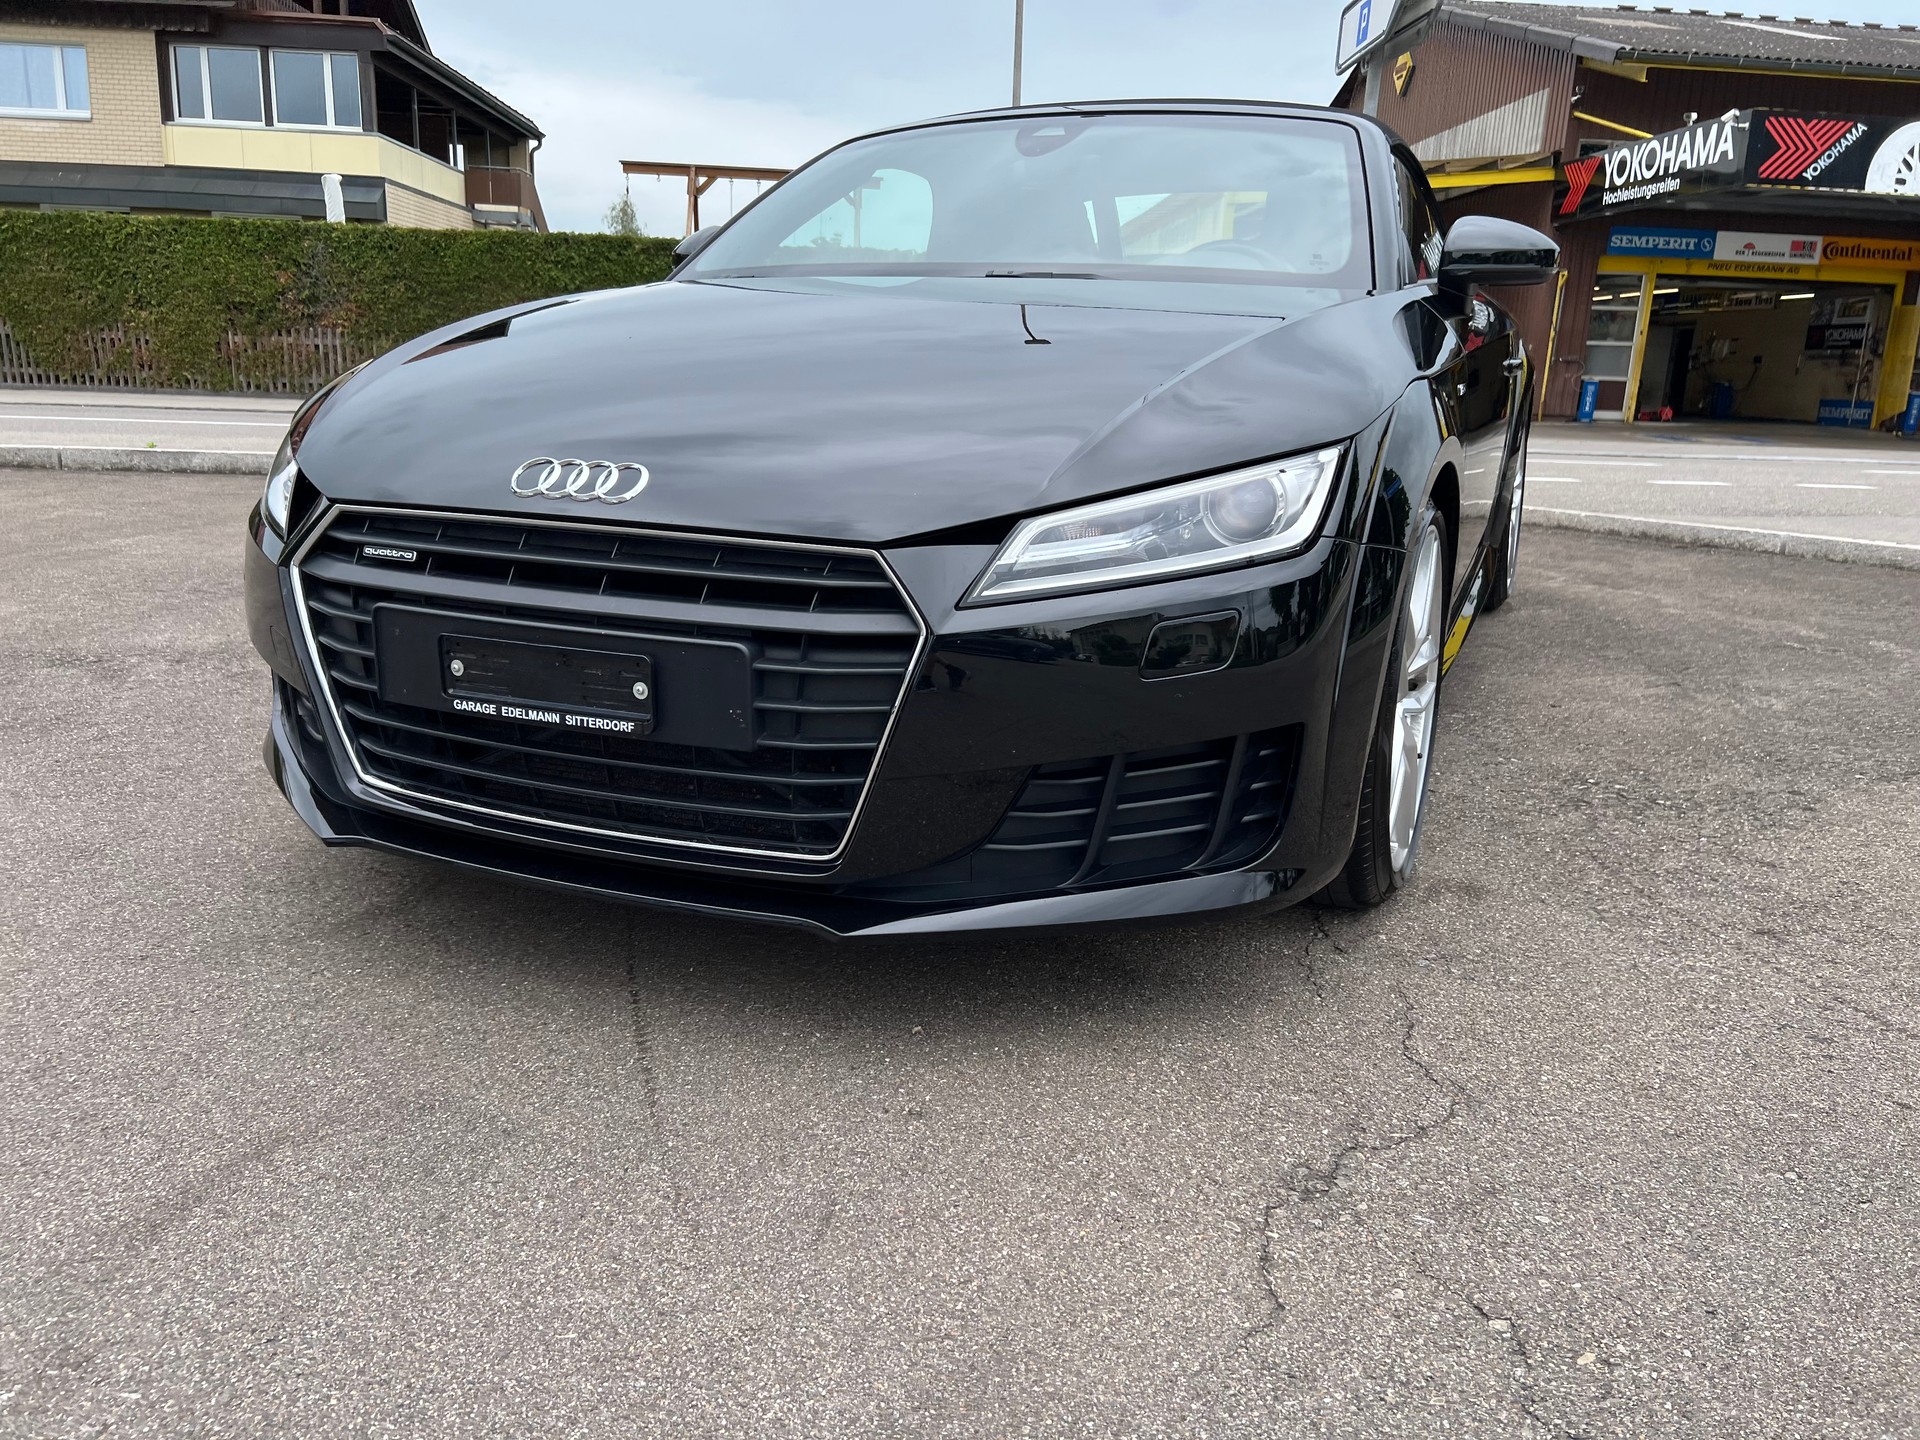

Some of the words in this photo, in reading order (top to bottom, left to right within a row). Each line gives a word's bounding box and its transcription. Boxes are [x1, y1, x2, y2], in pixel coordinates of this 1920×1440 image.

[1603, 121, 1734, 189] YOKOHAMA
[1802, 122, 1868, 181] YOKOHAMA
[1602, 177, 1680, 206] Hochleistungsreifen
[1610, 234, 1698, 250] SEMPERIT
[1822, 241, 1913, 261] Continental
[1707, 262, 1731, 271] PNEU
[1734, 263, 1785, 273] EDELMANN
[365, 547, 413, 559] quattro
[453, 699, 497, 715] GARAGE
[501, 706, 560, 724] EDELMANN
[565, 714, 635, 733] SITTERDORF
